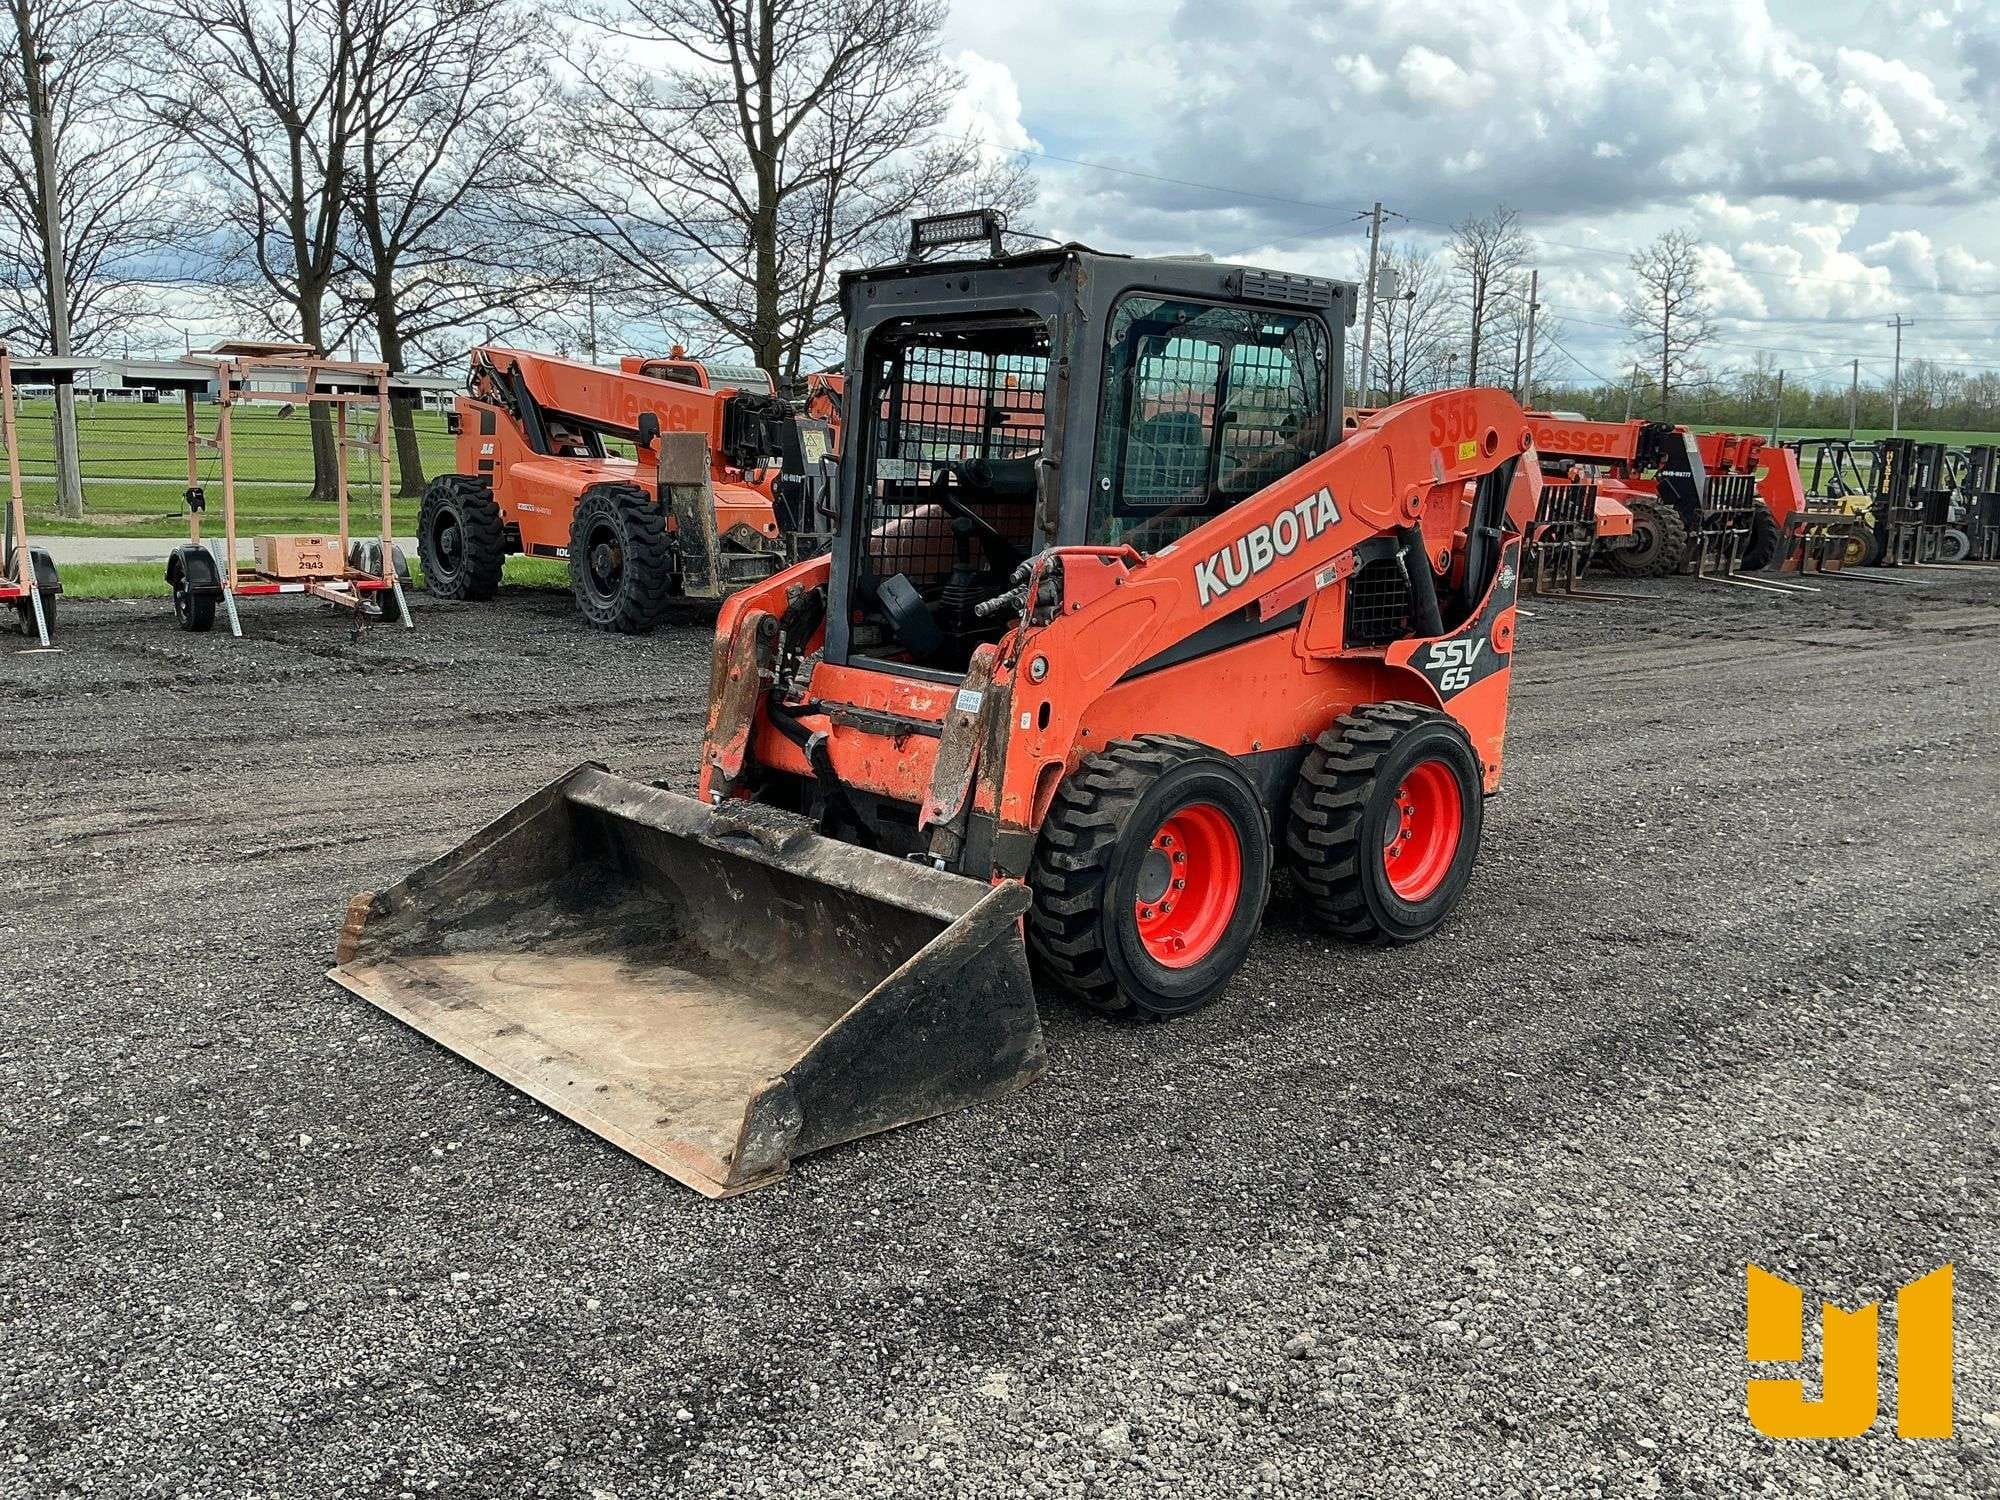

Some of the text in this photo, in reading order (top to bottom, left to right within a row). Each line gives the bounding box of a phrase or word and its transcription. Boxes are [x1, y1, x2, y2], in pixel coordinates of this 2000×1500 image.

[1194, 486, 1342, 606] KUBOTA
[298, 561, 324, 570] 2943
[1425, 637, 1486, 669] SSV
[1440, 666, 1472, 691] 65
